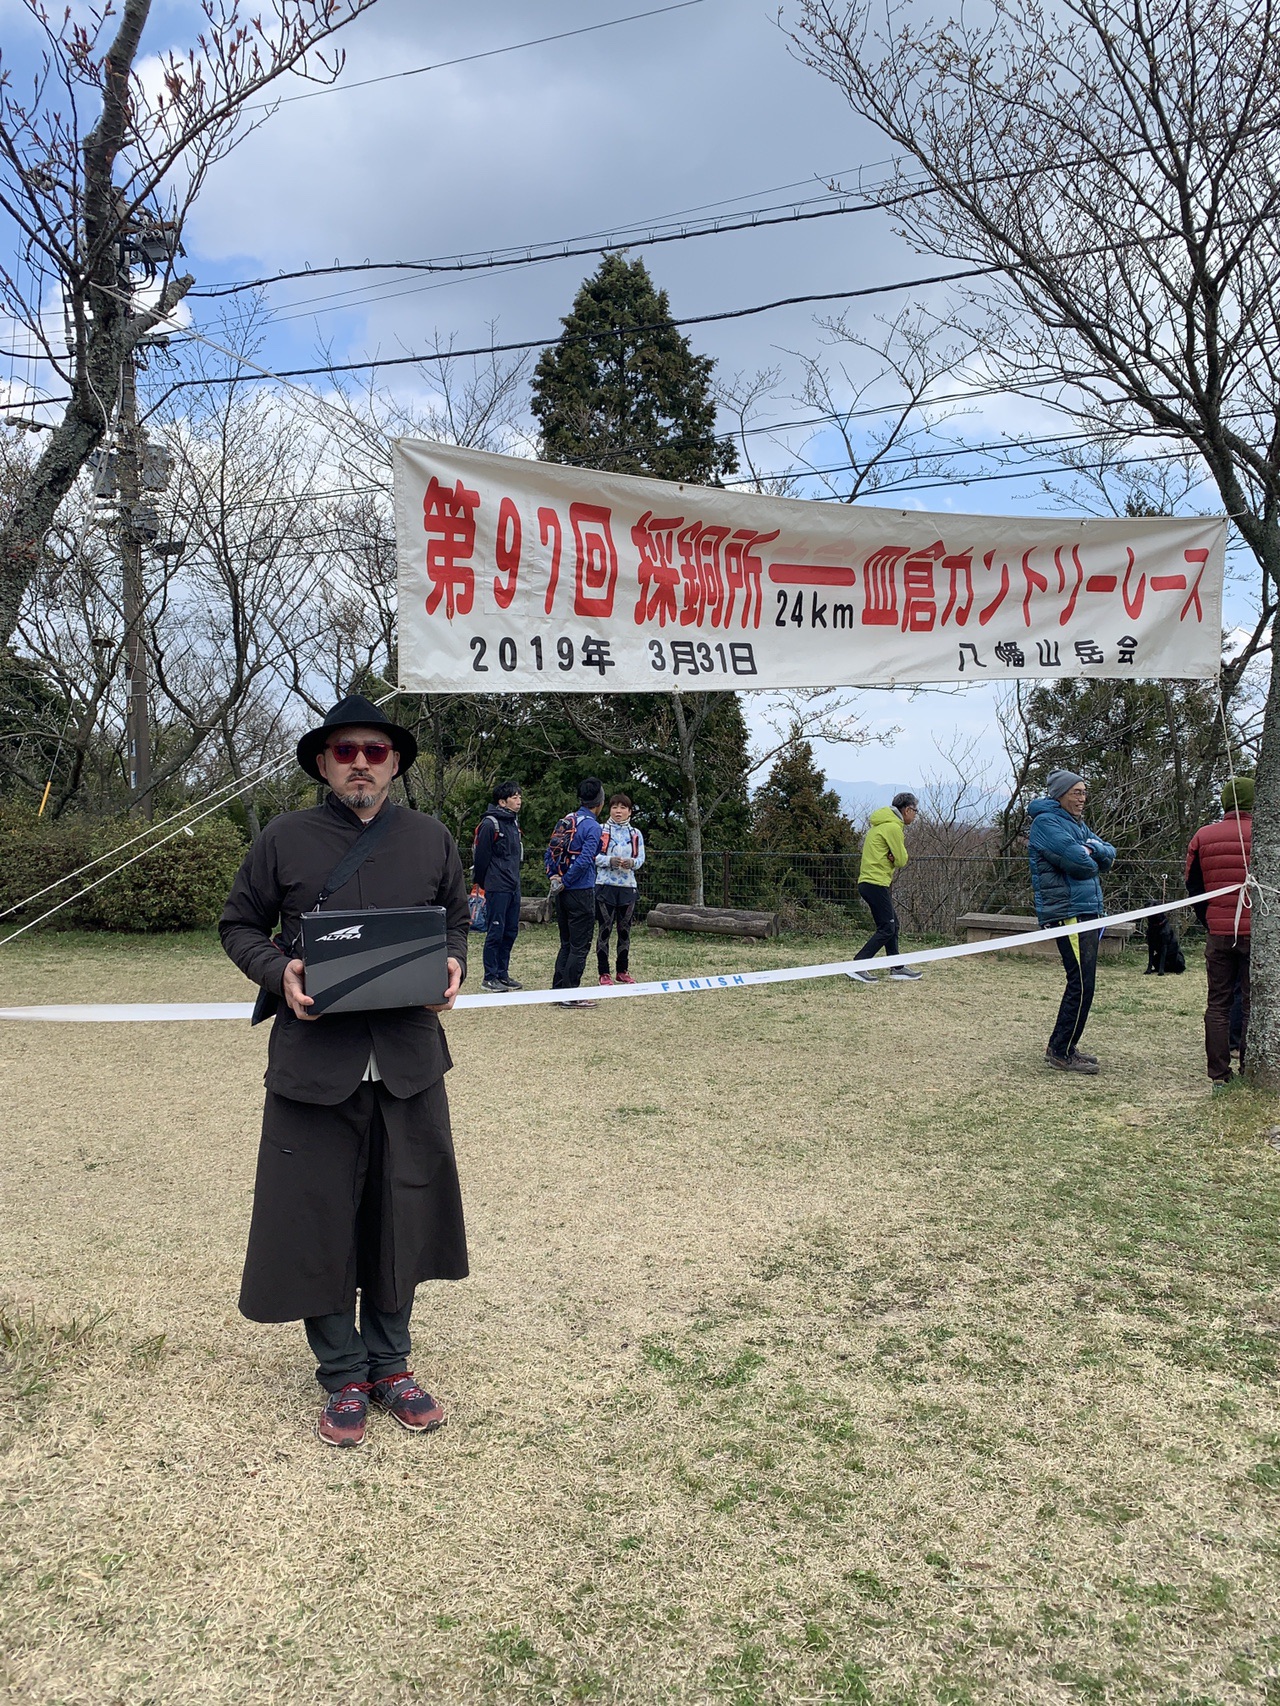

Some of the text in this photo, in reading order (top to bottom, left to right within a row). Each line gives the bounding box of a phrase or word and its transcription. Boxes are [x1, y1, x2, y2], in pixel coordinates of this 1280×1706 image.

[776, 590, 853, 628] 24km
[470, 636, 757, 675] 2019年 3月31日
[959, 636, 1138, 671] 八幡山岳会
[661, 976, 744, 991] FINISH
